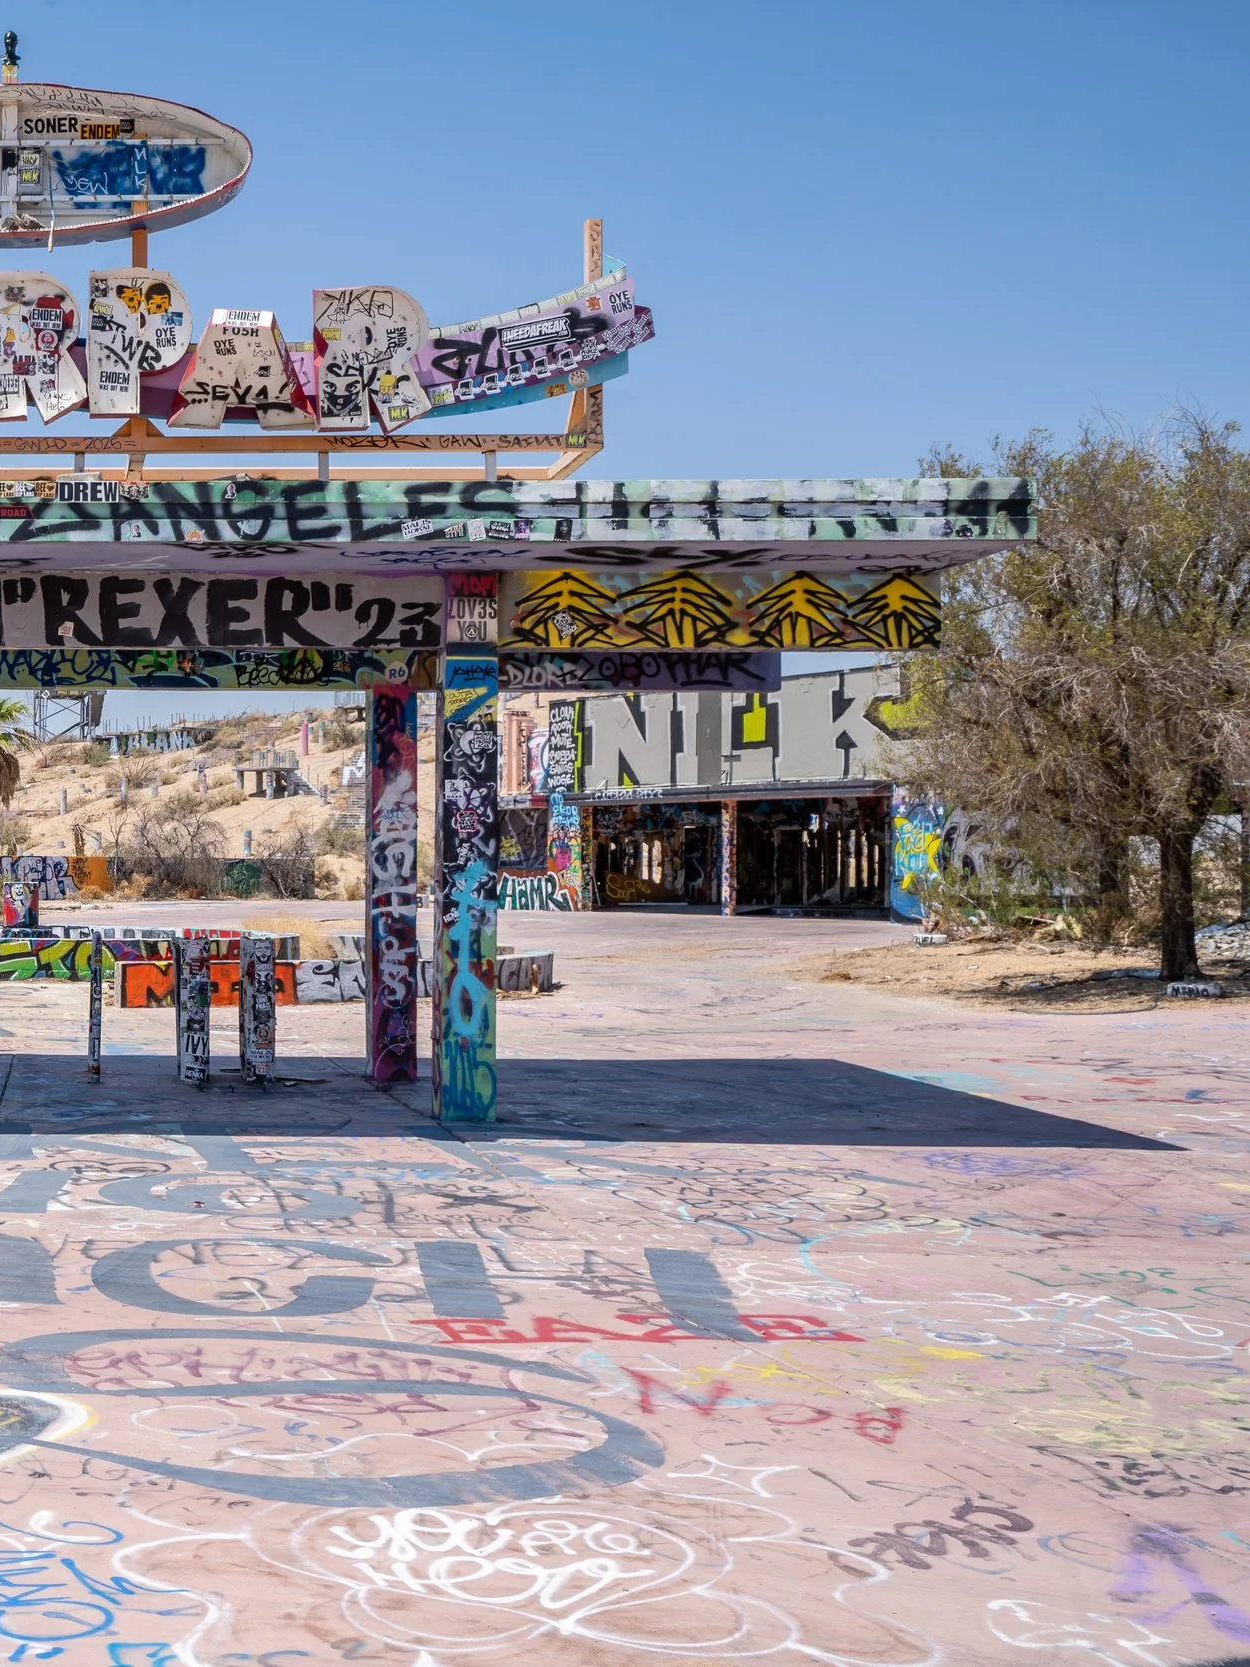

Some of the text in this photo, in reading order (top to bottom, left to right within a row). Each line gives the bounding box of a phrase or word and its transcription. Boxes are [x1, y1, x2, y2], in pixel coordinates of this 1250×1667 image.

[23, 117, 79, 135] SONER
[80, 123, 120, 139] ENDEM
[609, 290, 631, 305] OYE
[32, 308, 62, 322] ENDEM
[611, 300, 633, 315] RUNS
[227, 310, 261, 322] ENDEM
[51, 322, 62, 330] HERE
[155, 327, 176, 338] OYE
[502, 317, 569, 343] INEEDAFREAK
[156, 335, 177, 348] RUNS
[213, 338, 234, 350] OYE
[215, 346, 237, 356] RUNS
[99, 370, 130, 385] ENDEM
[58, 482, 118, 502] DREW
[448, 598, 498, 619] LOV3S
[388, 667, 406, 680] R6
[186, 1034, 209, 1054] IVY
